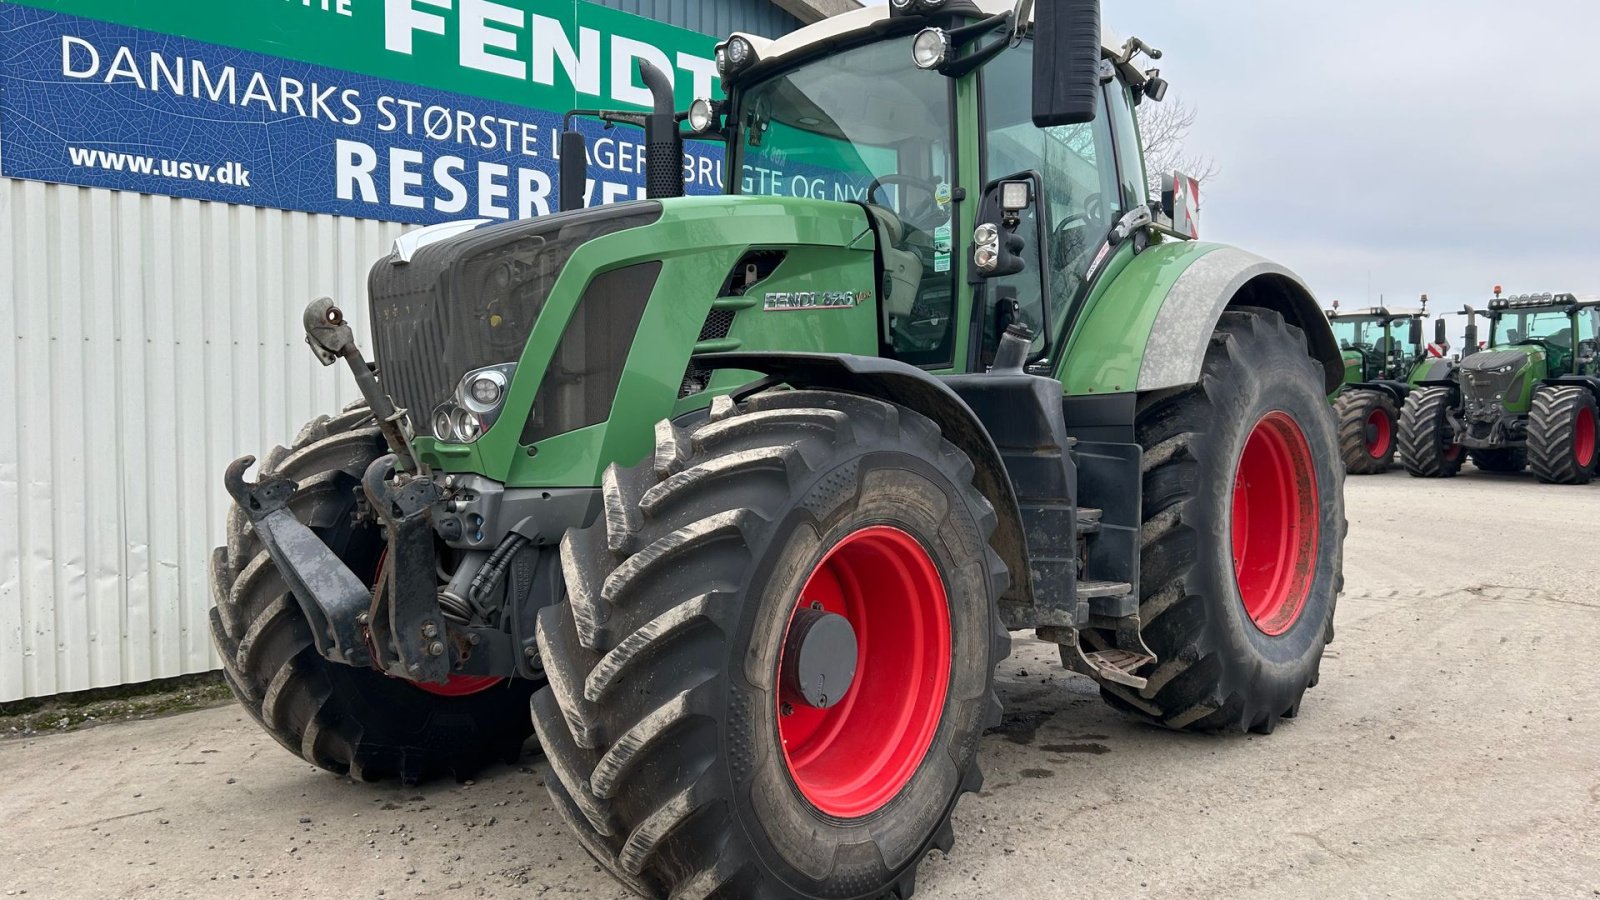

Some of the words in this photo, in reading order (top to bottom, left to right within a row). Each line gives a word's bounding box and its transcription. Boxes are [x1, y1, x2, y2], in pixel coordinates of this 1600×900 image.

[384, 0, 721, 107] FENDT
[62, 35, 362, 126] DANMARKS
[377, 96, 538, 156] STØRSTE
[791, 175, 825, 200] OG
[834, 182, 869, 202] NY
[68, 146, 250, 188] www.usv.dk
[336, 138, 647, 220] RESER
[763, 291, 819, 310] FENDT
